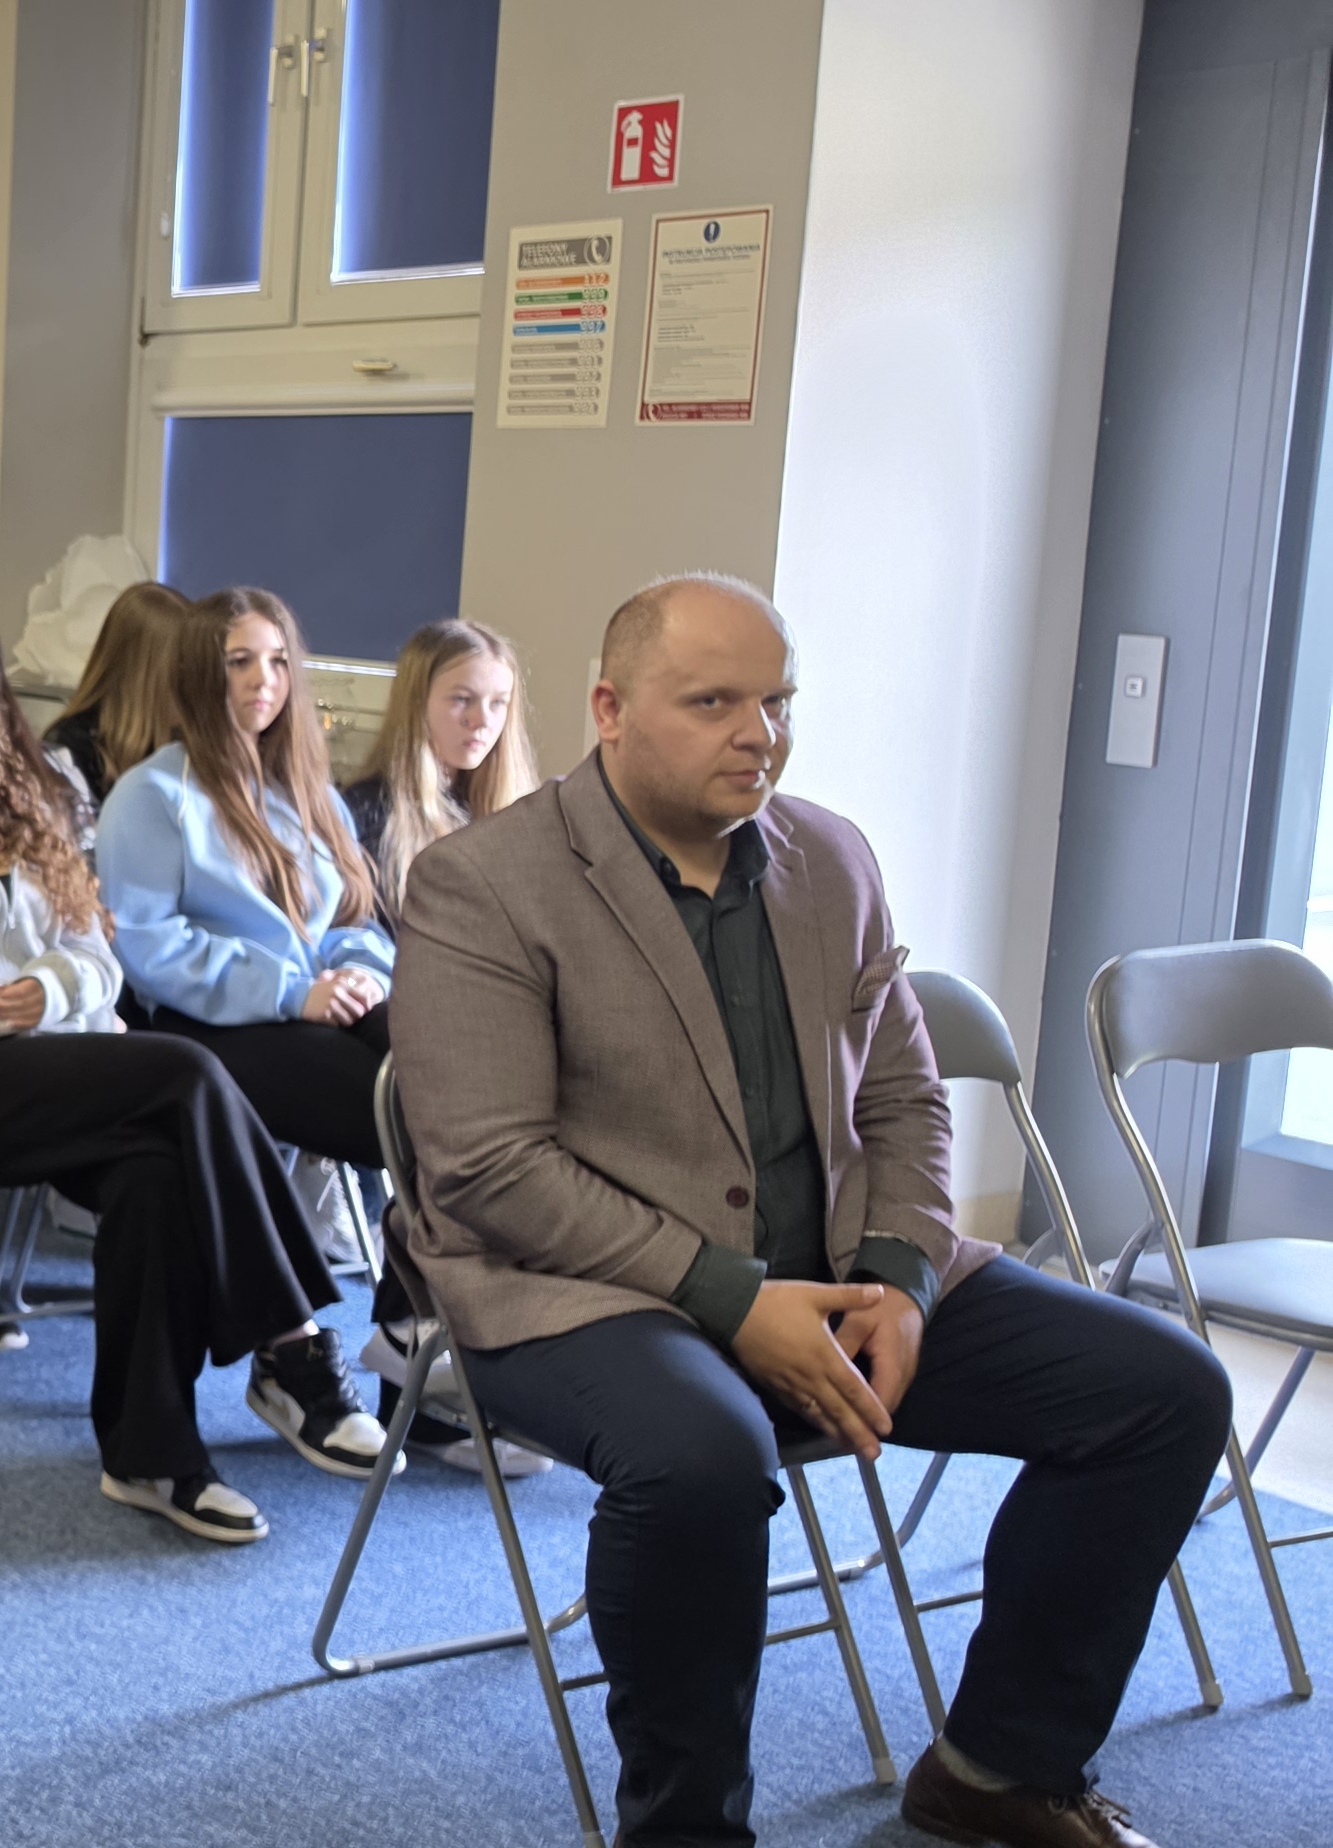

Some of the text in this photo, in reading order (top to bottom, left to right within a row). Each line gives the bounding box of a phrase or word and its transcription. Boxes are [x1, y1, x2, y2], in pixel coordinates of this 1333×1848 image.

[583, 273, 607, 287] 112
[581, 289, 606, 303] 999
[579, 305, 605, 319] 998
[578, 321, 604, 335] 997
